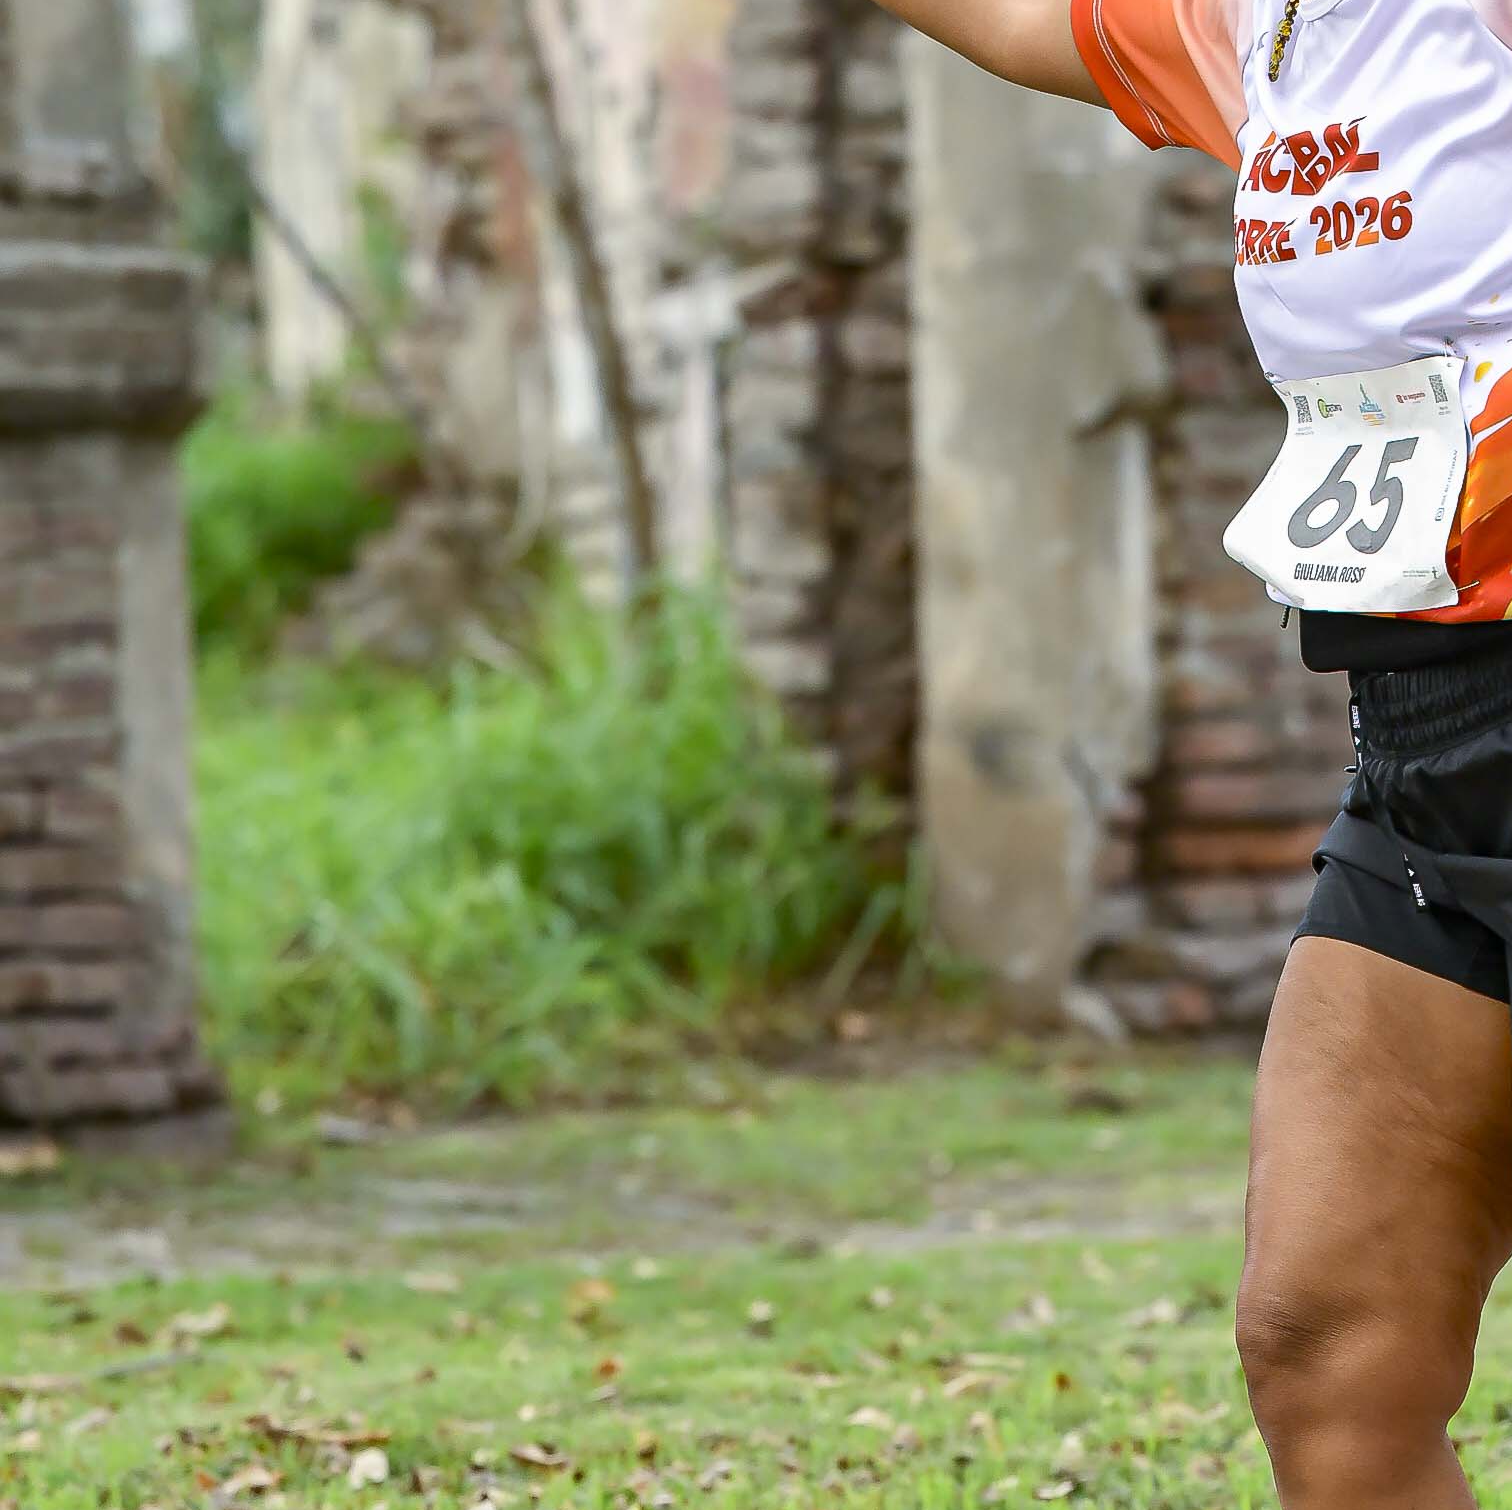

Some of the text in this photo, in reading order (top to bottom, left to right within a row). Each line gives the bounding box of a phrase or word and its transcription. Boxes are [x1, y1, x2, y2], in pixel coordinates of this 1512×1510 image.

[1310, 191, 1413, 256] 2026
[1288, 436, 1419, 554] 65
[1294, 562, 1339, 582] GIULIANA
